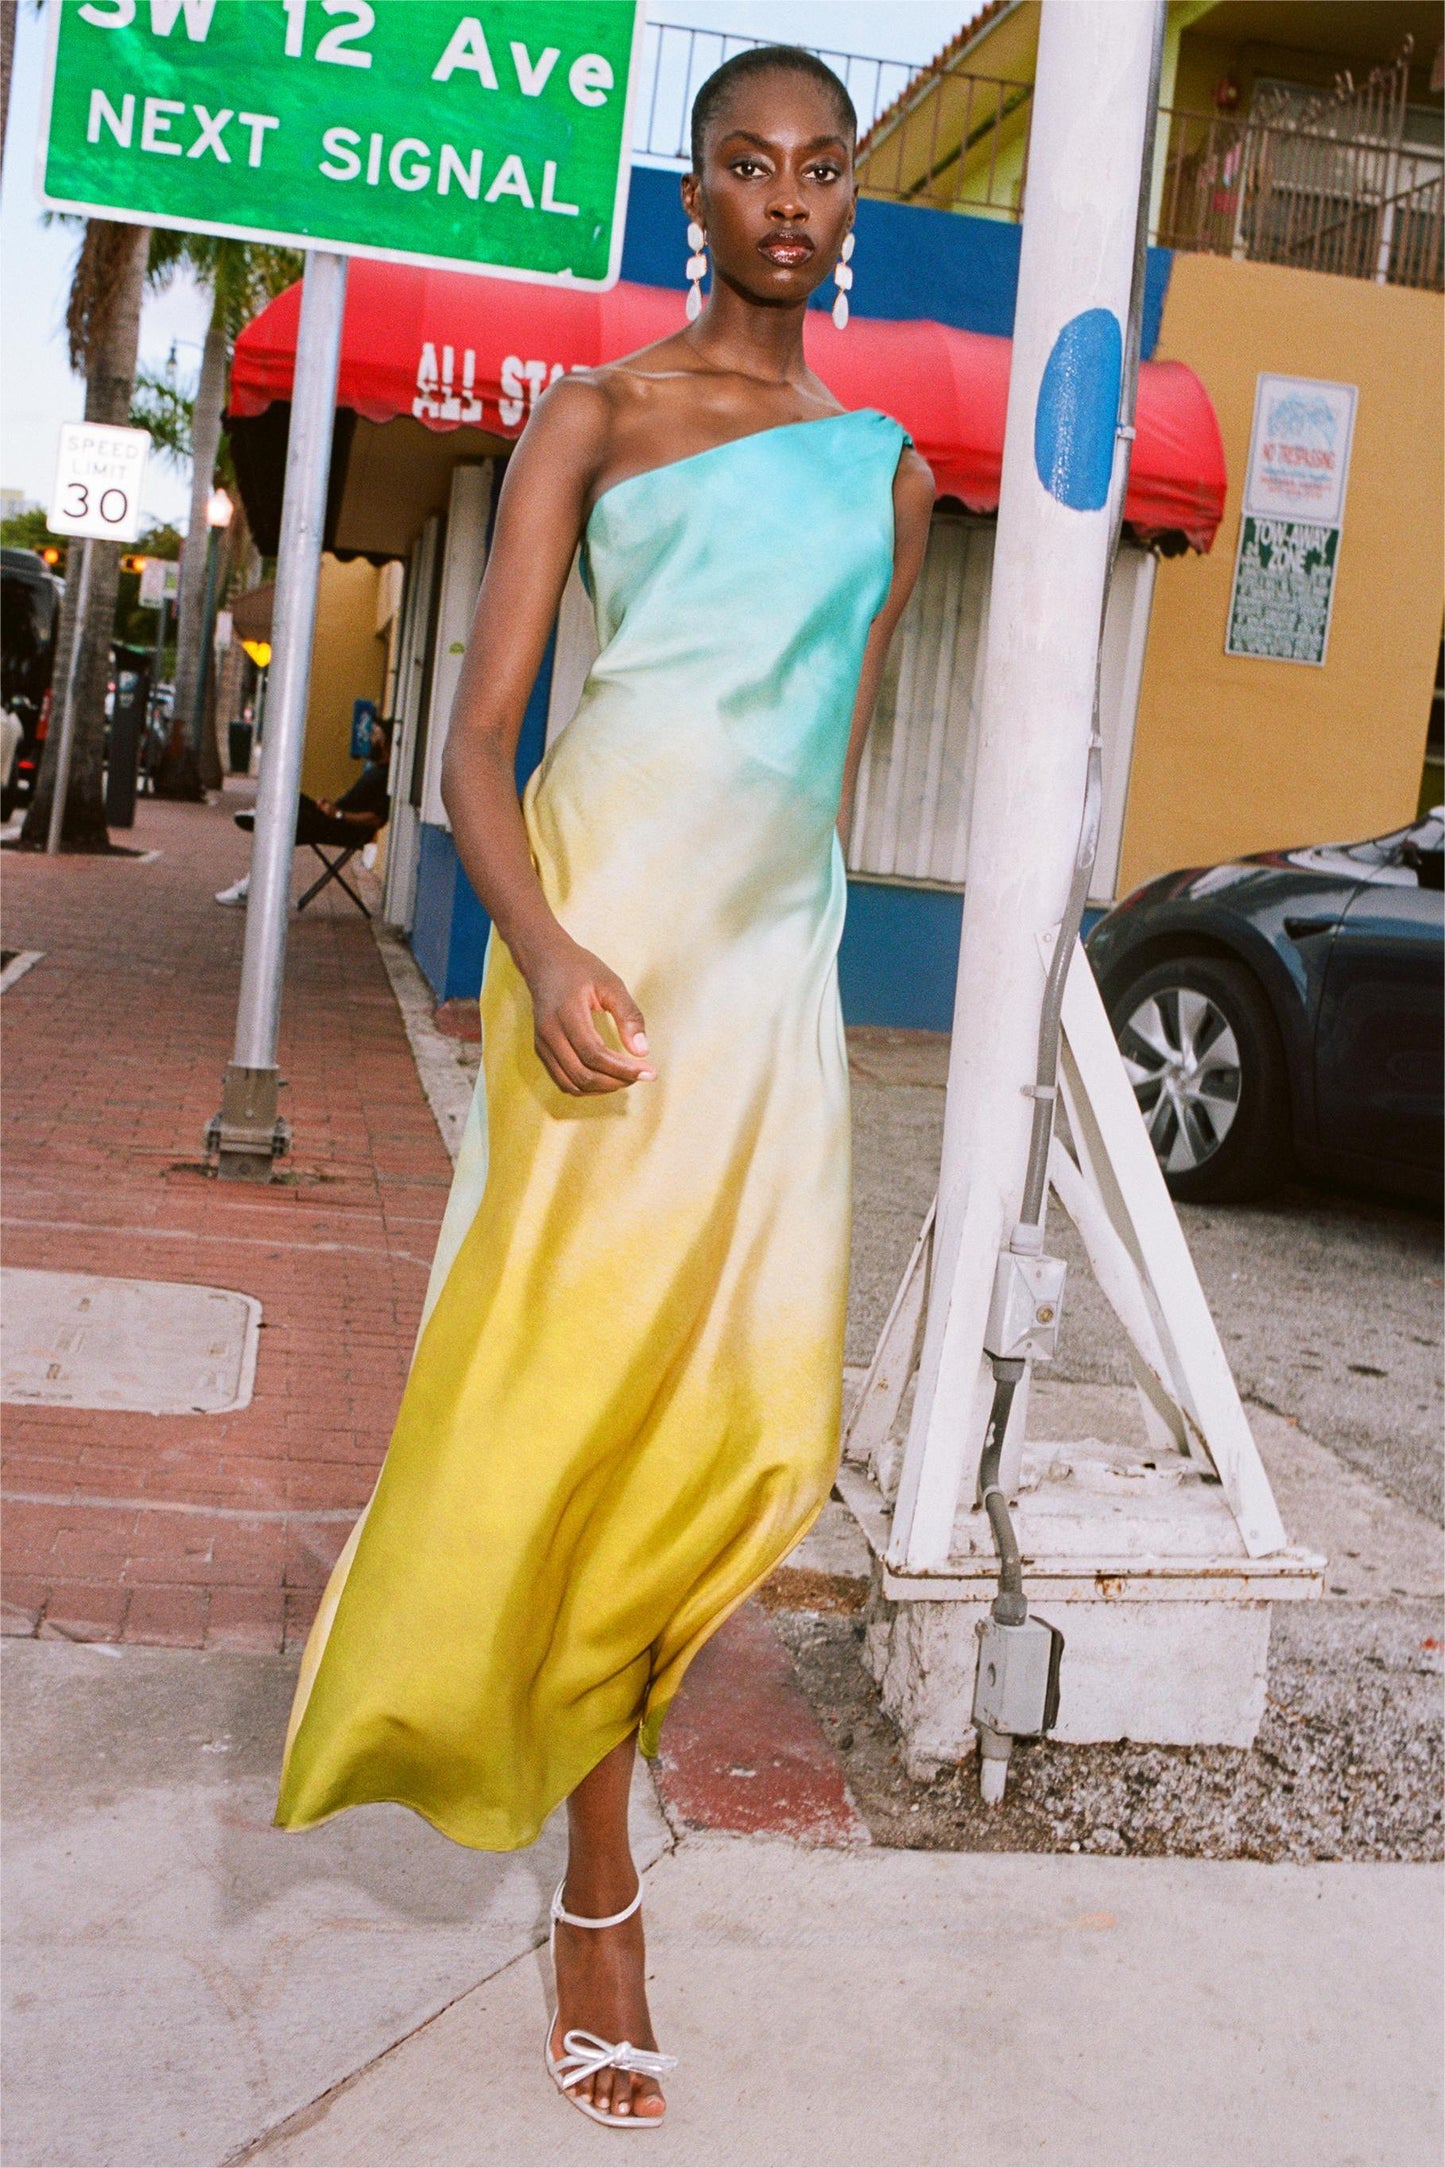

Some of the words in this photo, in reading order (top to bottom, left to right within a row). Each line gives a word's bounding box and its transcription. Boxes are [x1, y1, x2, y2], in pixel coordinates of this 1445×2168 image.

[283, 0, 376, 69] 12
[431, 16, 616, 108] Ave
[86, 88, 280, 169] NEXT
[318, 127, 581, 216] SIGNAL
[411, 341, 483, 423] ALL
[67, 435, 140, 460] SPEED
[71, 458, 128, 481] LIMIT
[62, 482, 129, 524] 30
[1254, 519, 1332, 550] TOW-AWAY
[1268, 546, 1307, 573] ZONE
